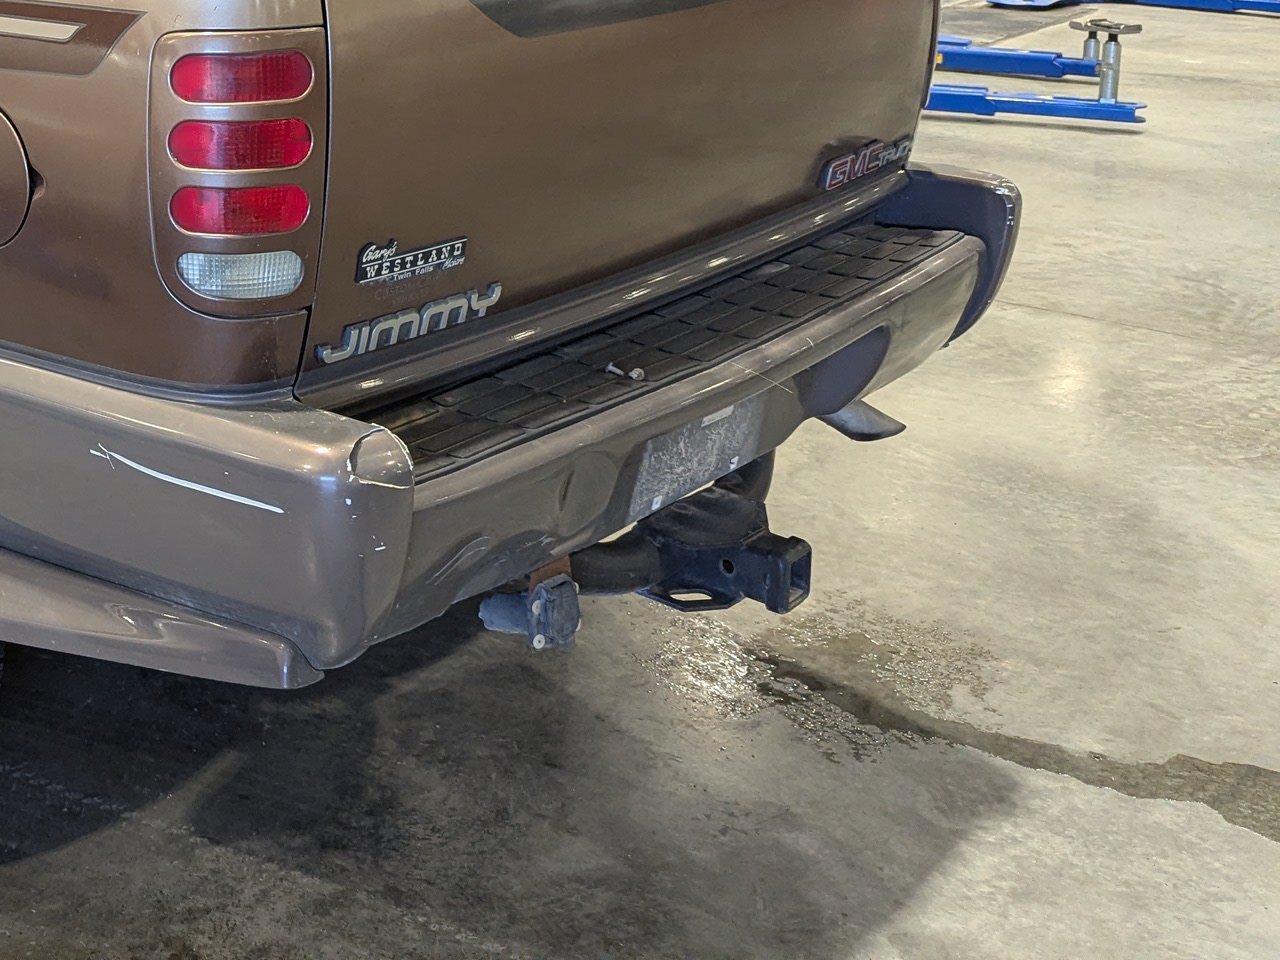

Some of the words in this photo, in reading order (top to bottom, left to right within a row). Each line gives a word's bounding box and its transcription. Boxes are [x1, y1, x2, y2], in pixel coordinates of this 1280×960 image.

[825, 142, 885, 191] GMC
[362, 241, 398, 263] Gary's
[366, 242, 463, 279] WESTLAND
[393, 270, 413, 281] Twin
[415, 265, 435, 276] Falls
[317, 282, 502, 364] JIMMY
